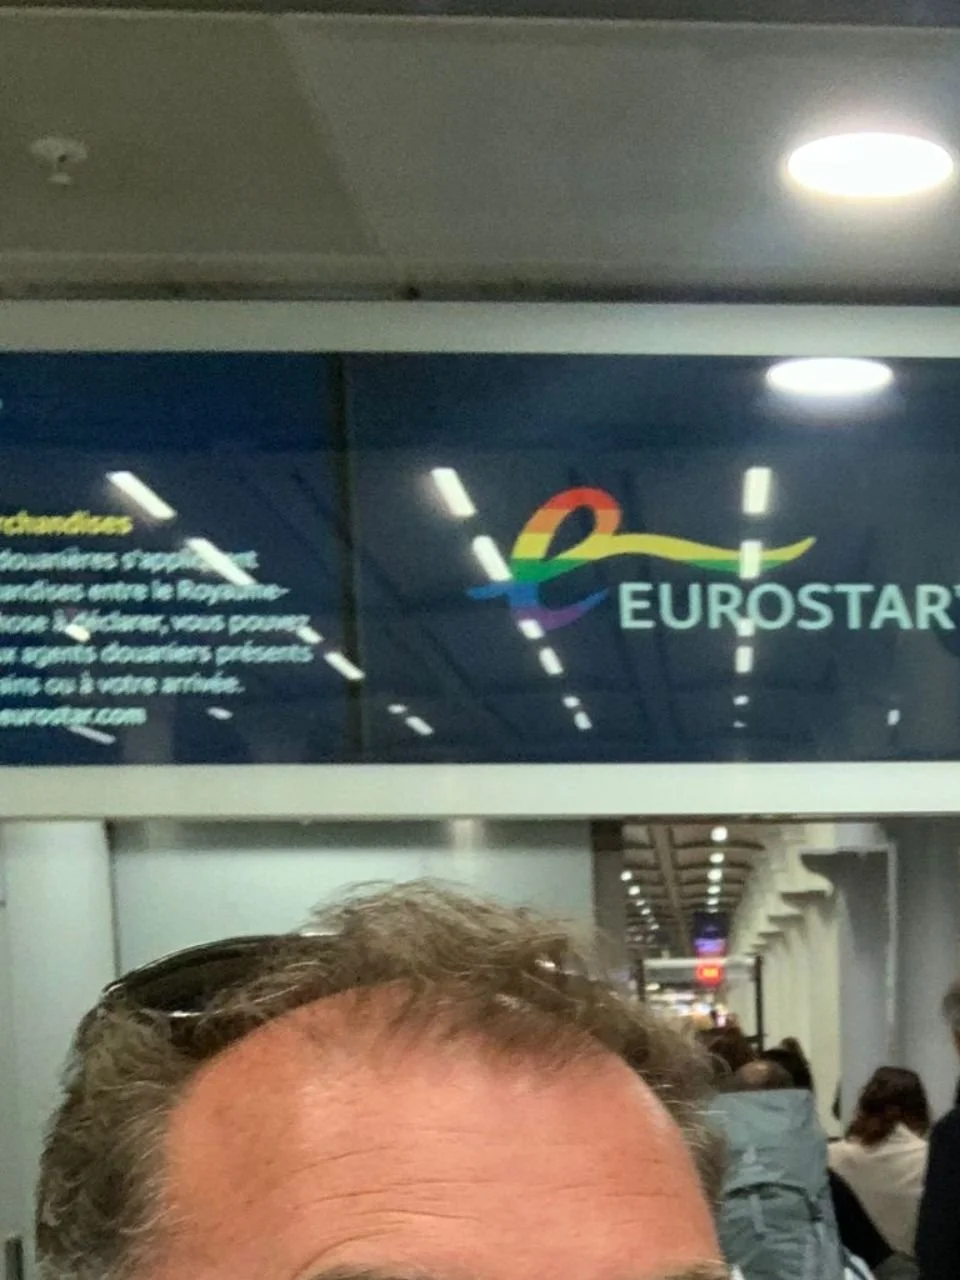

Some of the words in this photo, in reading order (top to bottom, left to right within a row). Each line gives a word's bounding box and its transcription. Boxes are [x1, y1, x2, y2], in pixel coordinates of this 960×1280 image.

[88, 581, 149, 602] entre
[151, 579, 174, 602] le
[170, 614, 226, 633] vous
[21, 645, 98, 669] agents
[215, 640, 314, 667] présents
[44, 676, 77, 696] ou
[97, 675, 158, 697] votre
